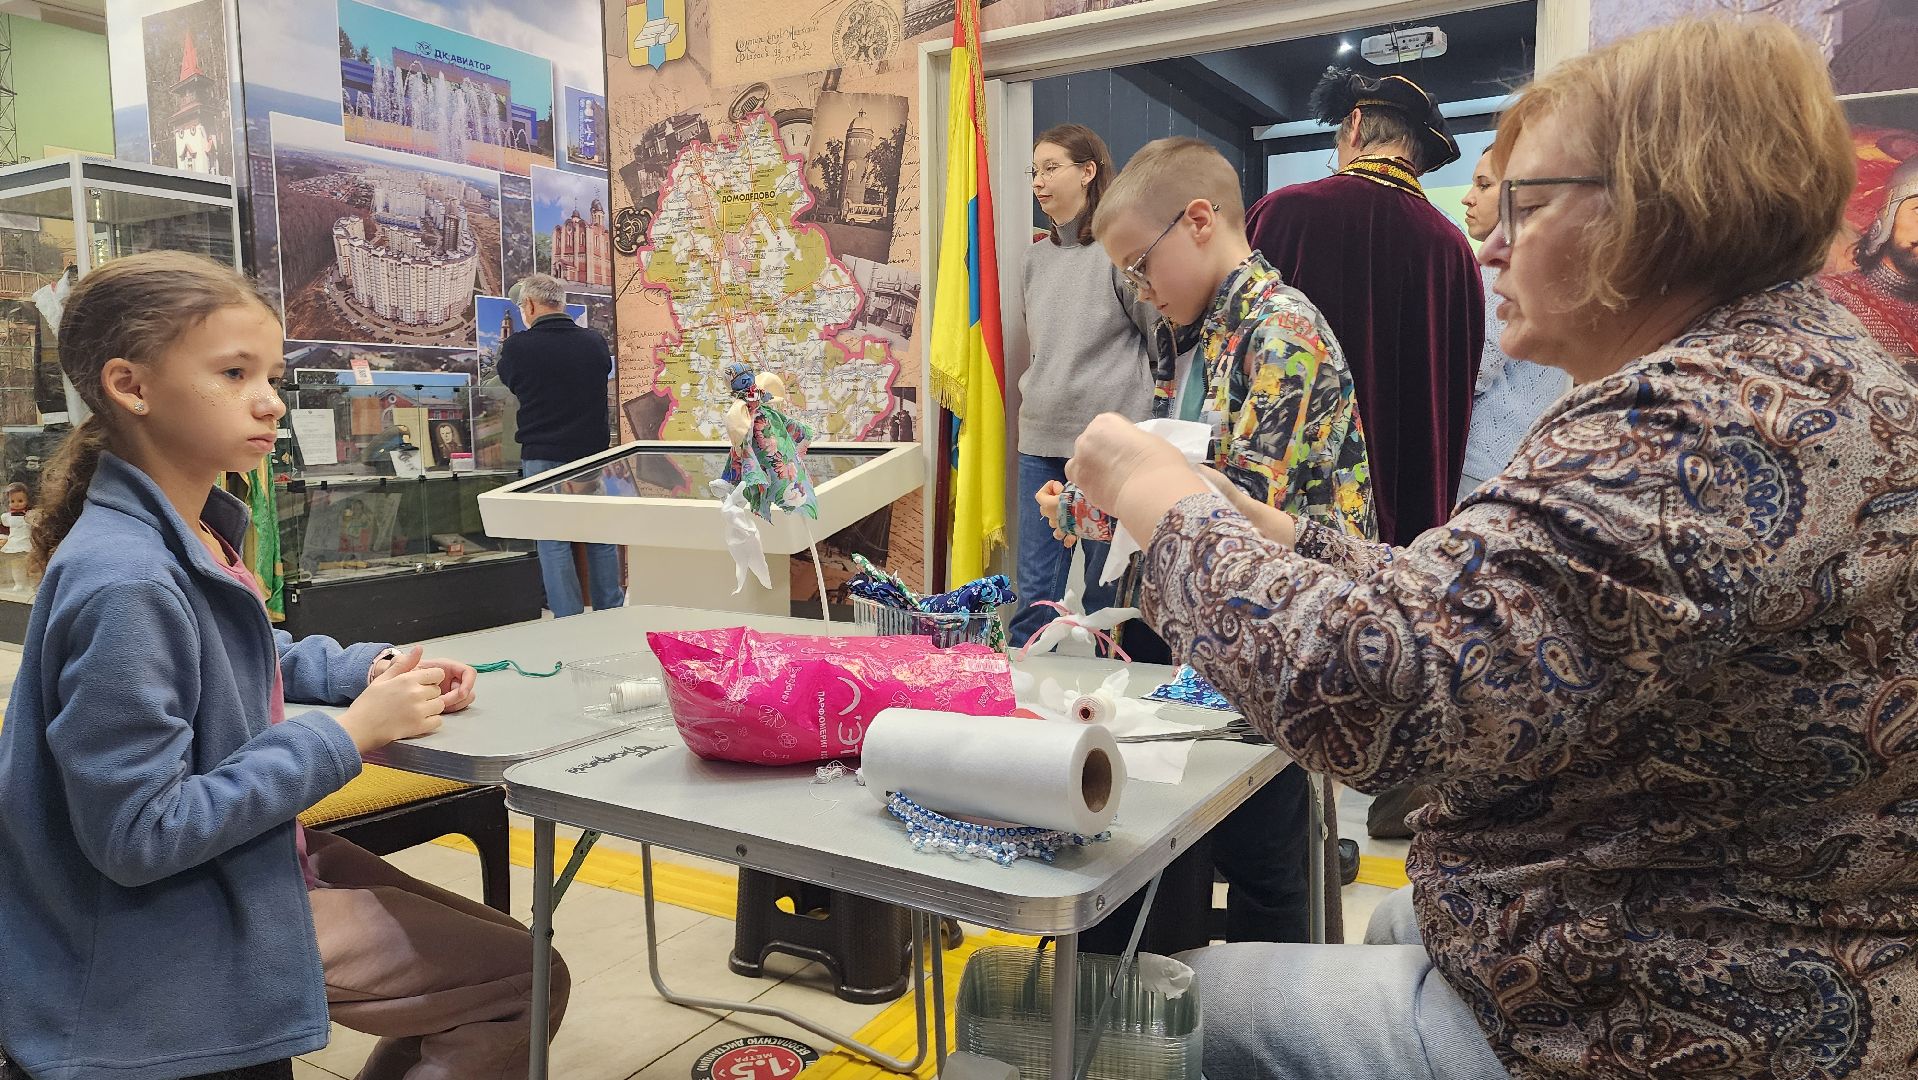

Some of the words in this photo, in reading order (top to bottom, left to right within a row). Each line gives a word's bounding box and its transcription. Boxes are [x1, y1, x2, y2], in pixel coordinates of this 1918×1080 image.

[434, 49, 449, 60] ДК
[450, 54, 491, 72] АВИАТОР
[721, 191, 776, 204] ДОМОДЕДОВО
[747, 1037, 811, 1055] БЕЗОПАСНУЮ
[734, 1053, 773, 1063] МЕТРА
